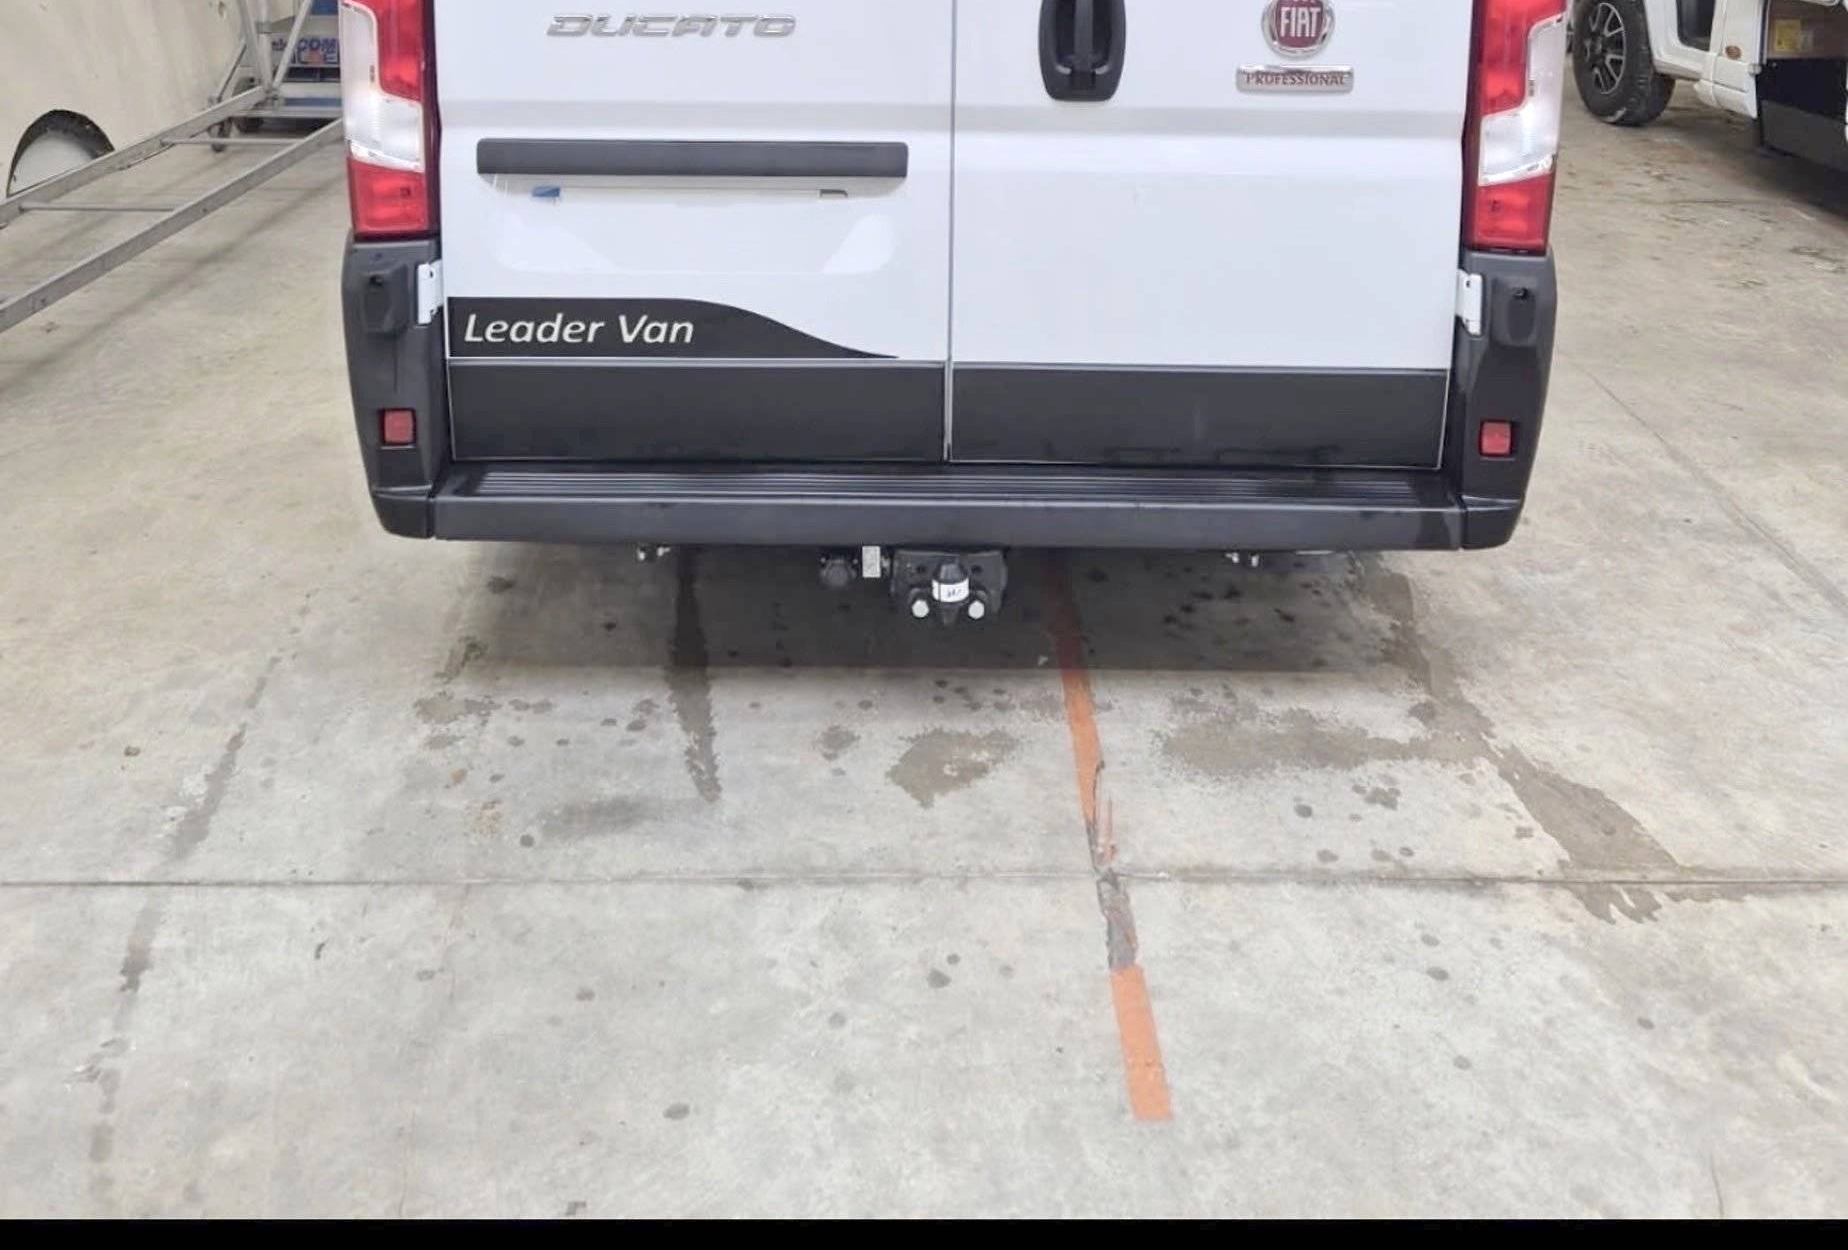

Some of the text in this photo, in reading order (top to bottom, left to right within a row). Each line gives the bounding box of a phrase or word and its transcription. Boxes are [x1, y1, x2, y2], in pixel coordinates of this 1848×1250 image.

[547, 14, 796, 38] DUCATO
[1280, 7, 1321, 37] FIAT
[1246, 71, 1346, 86] PROFESSIONAL
[464, 313, 694, 344] Leader Van
